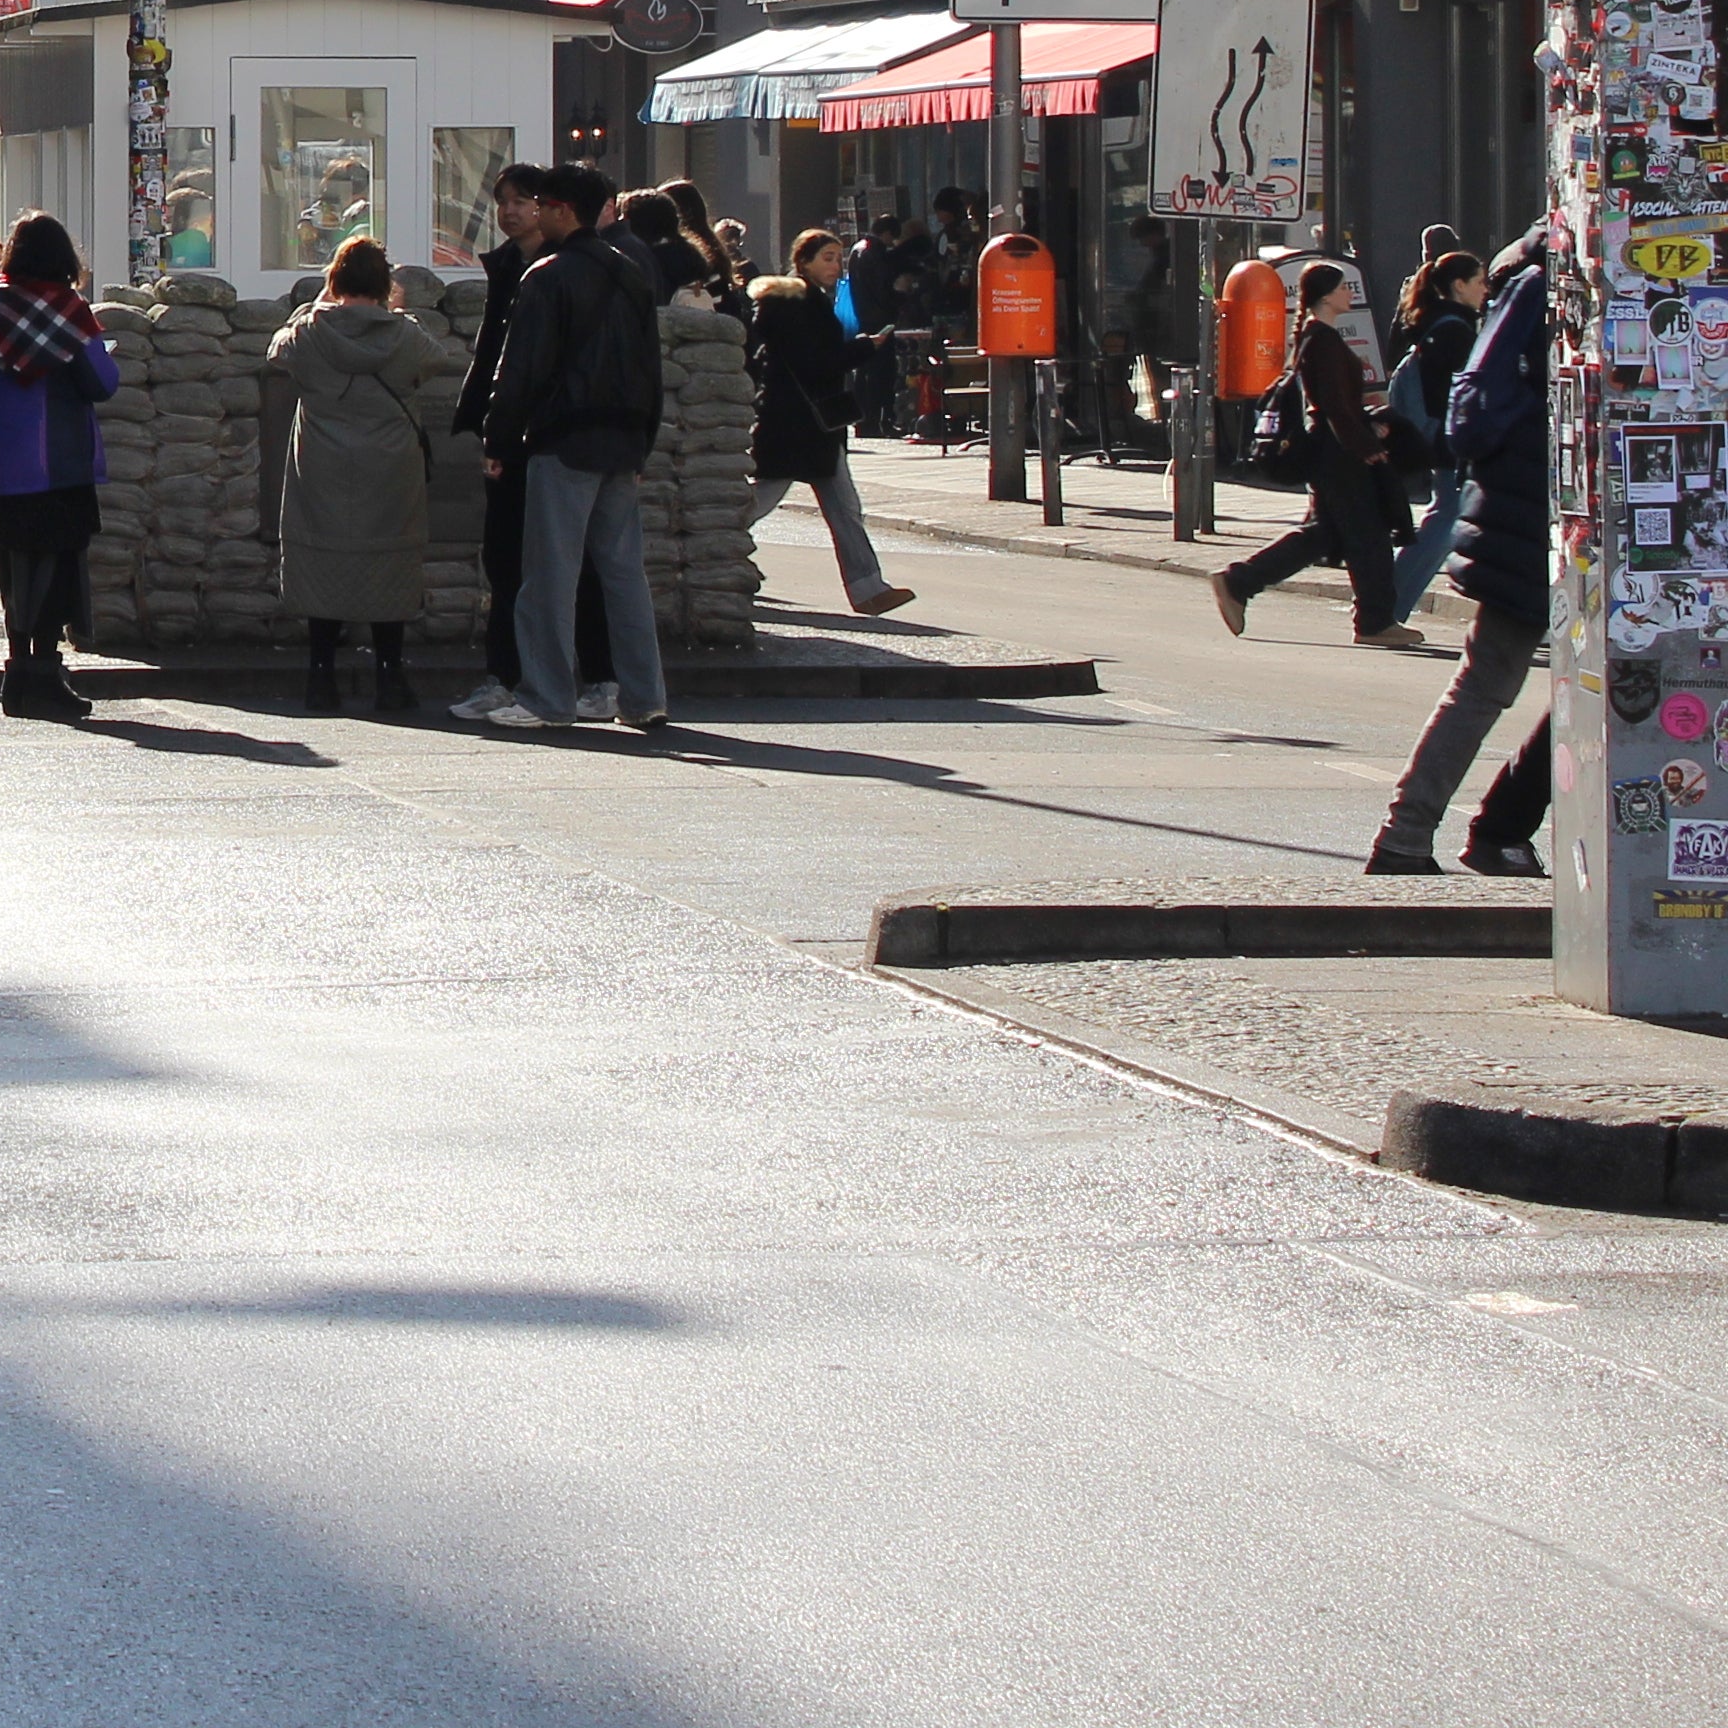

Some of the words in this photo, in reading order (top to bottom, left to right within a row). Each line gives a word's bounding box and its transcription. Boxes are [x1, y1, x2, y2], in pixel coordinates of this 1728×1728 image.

[1650, 58, 1697, 76] ZINTEKA
[1630, 200, 1680, 217] ASOCIAL
[991, 289, 1022, 297] Krassere
[991, 297, 1043, 306] Öffnungszeiten
